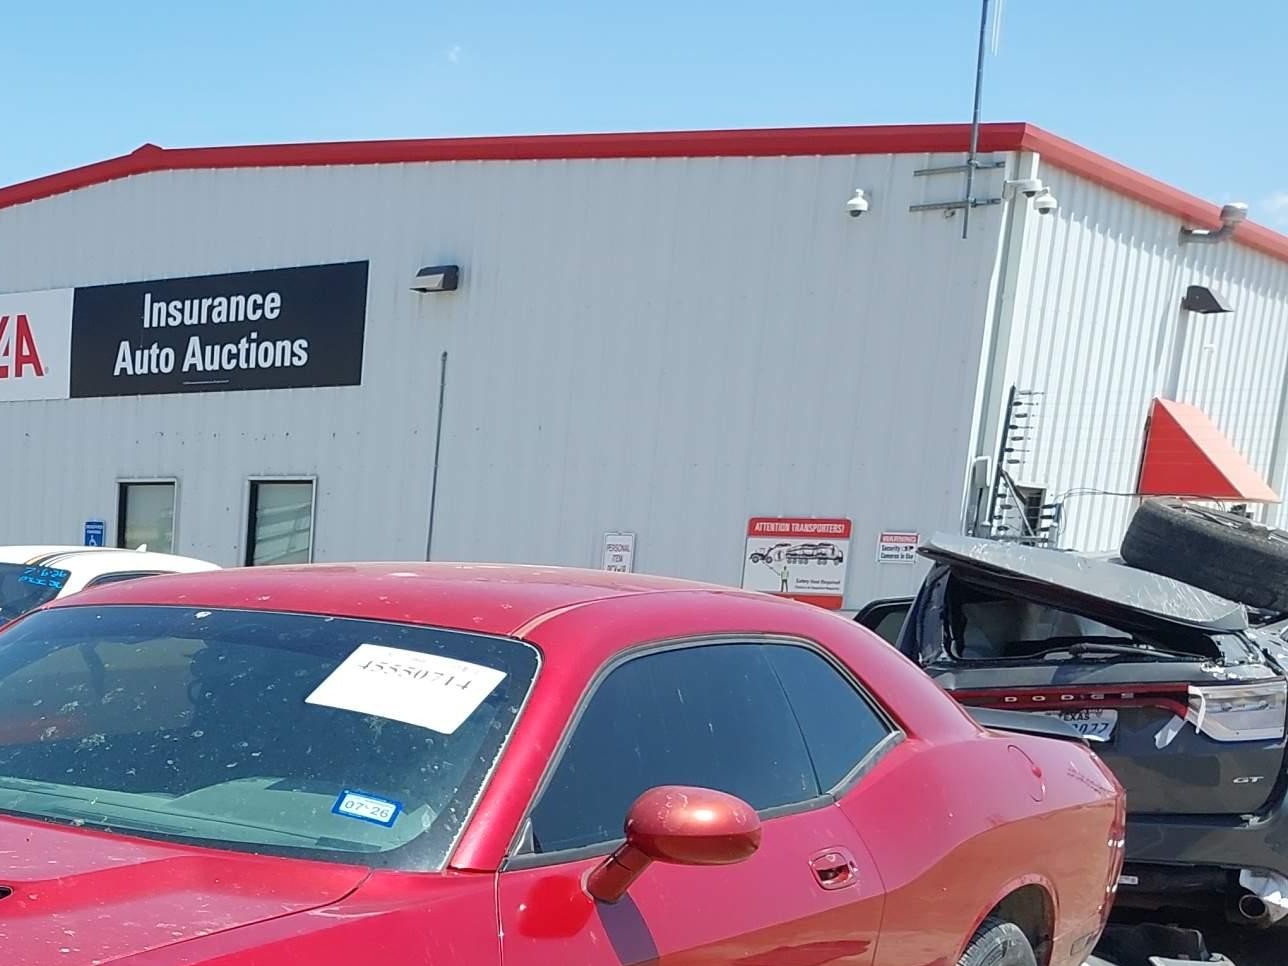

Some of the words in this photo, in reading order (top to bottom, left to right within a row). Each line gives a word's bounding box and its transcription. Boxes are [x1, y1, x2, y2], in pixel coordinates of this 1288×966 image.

[143, 292, 282, 328] Insurance
[113, 340, 175, 376] Auto
[182, 332, 309, 372] Auctions
[754, 522, 790, 532] ATTENTION
[791, 523, 845, 533] TRANSPORTERS!
[1004, 692, 1135, 703] DODGE
[1059, 711, 1090, 722] TEXAS
